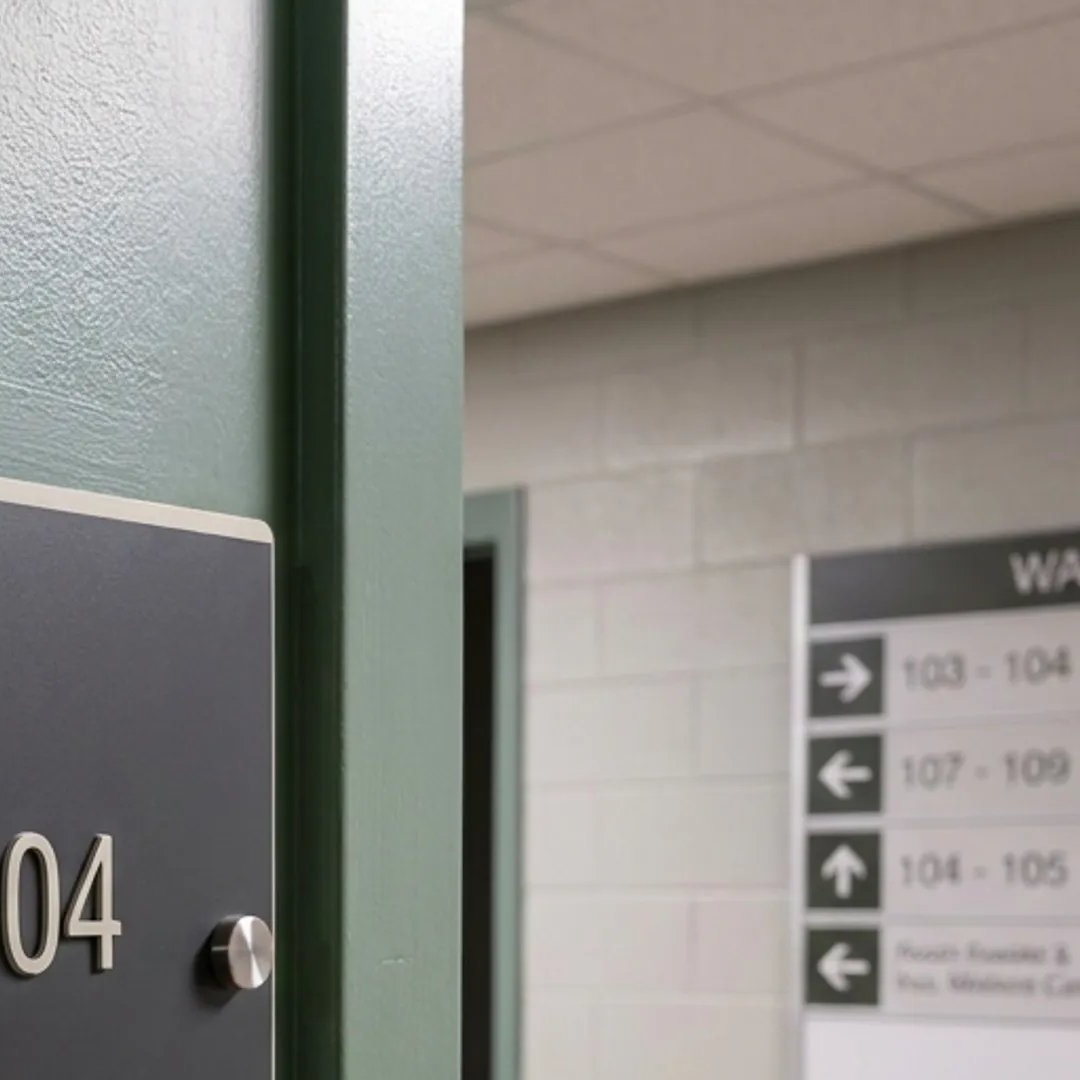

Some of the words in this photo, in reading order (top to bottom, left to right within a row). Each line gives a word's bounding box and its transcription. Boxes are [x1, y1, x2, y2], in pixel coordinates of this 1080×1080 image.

[1003, 645, 1071, 686] 104
[902, 751, 965, 790] 107
[1003, 747, 1071, 788] 109
[900, 851, 961, 887] 104
[1001, 850, 1069, 887] 105
